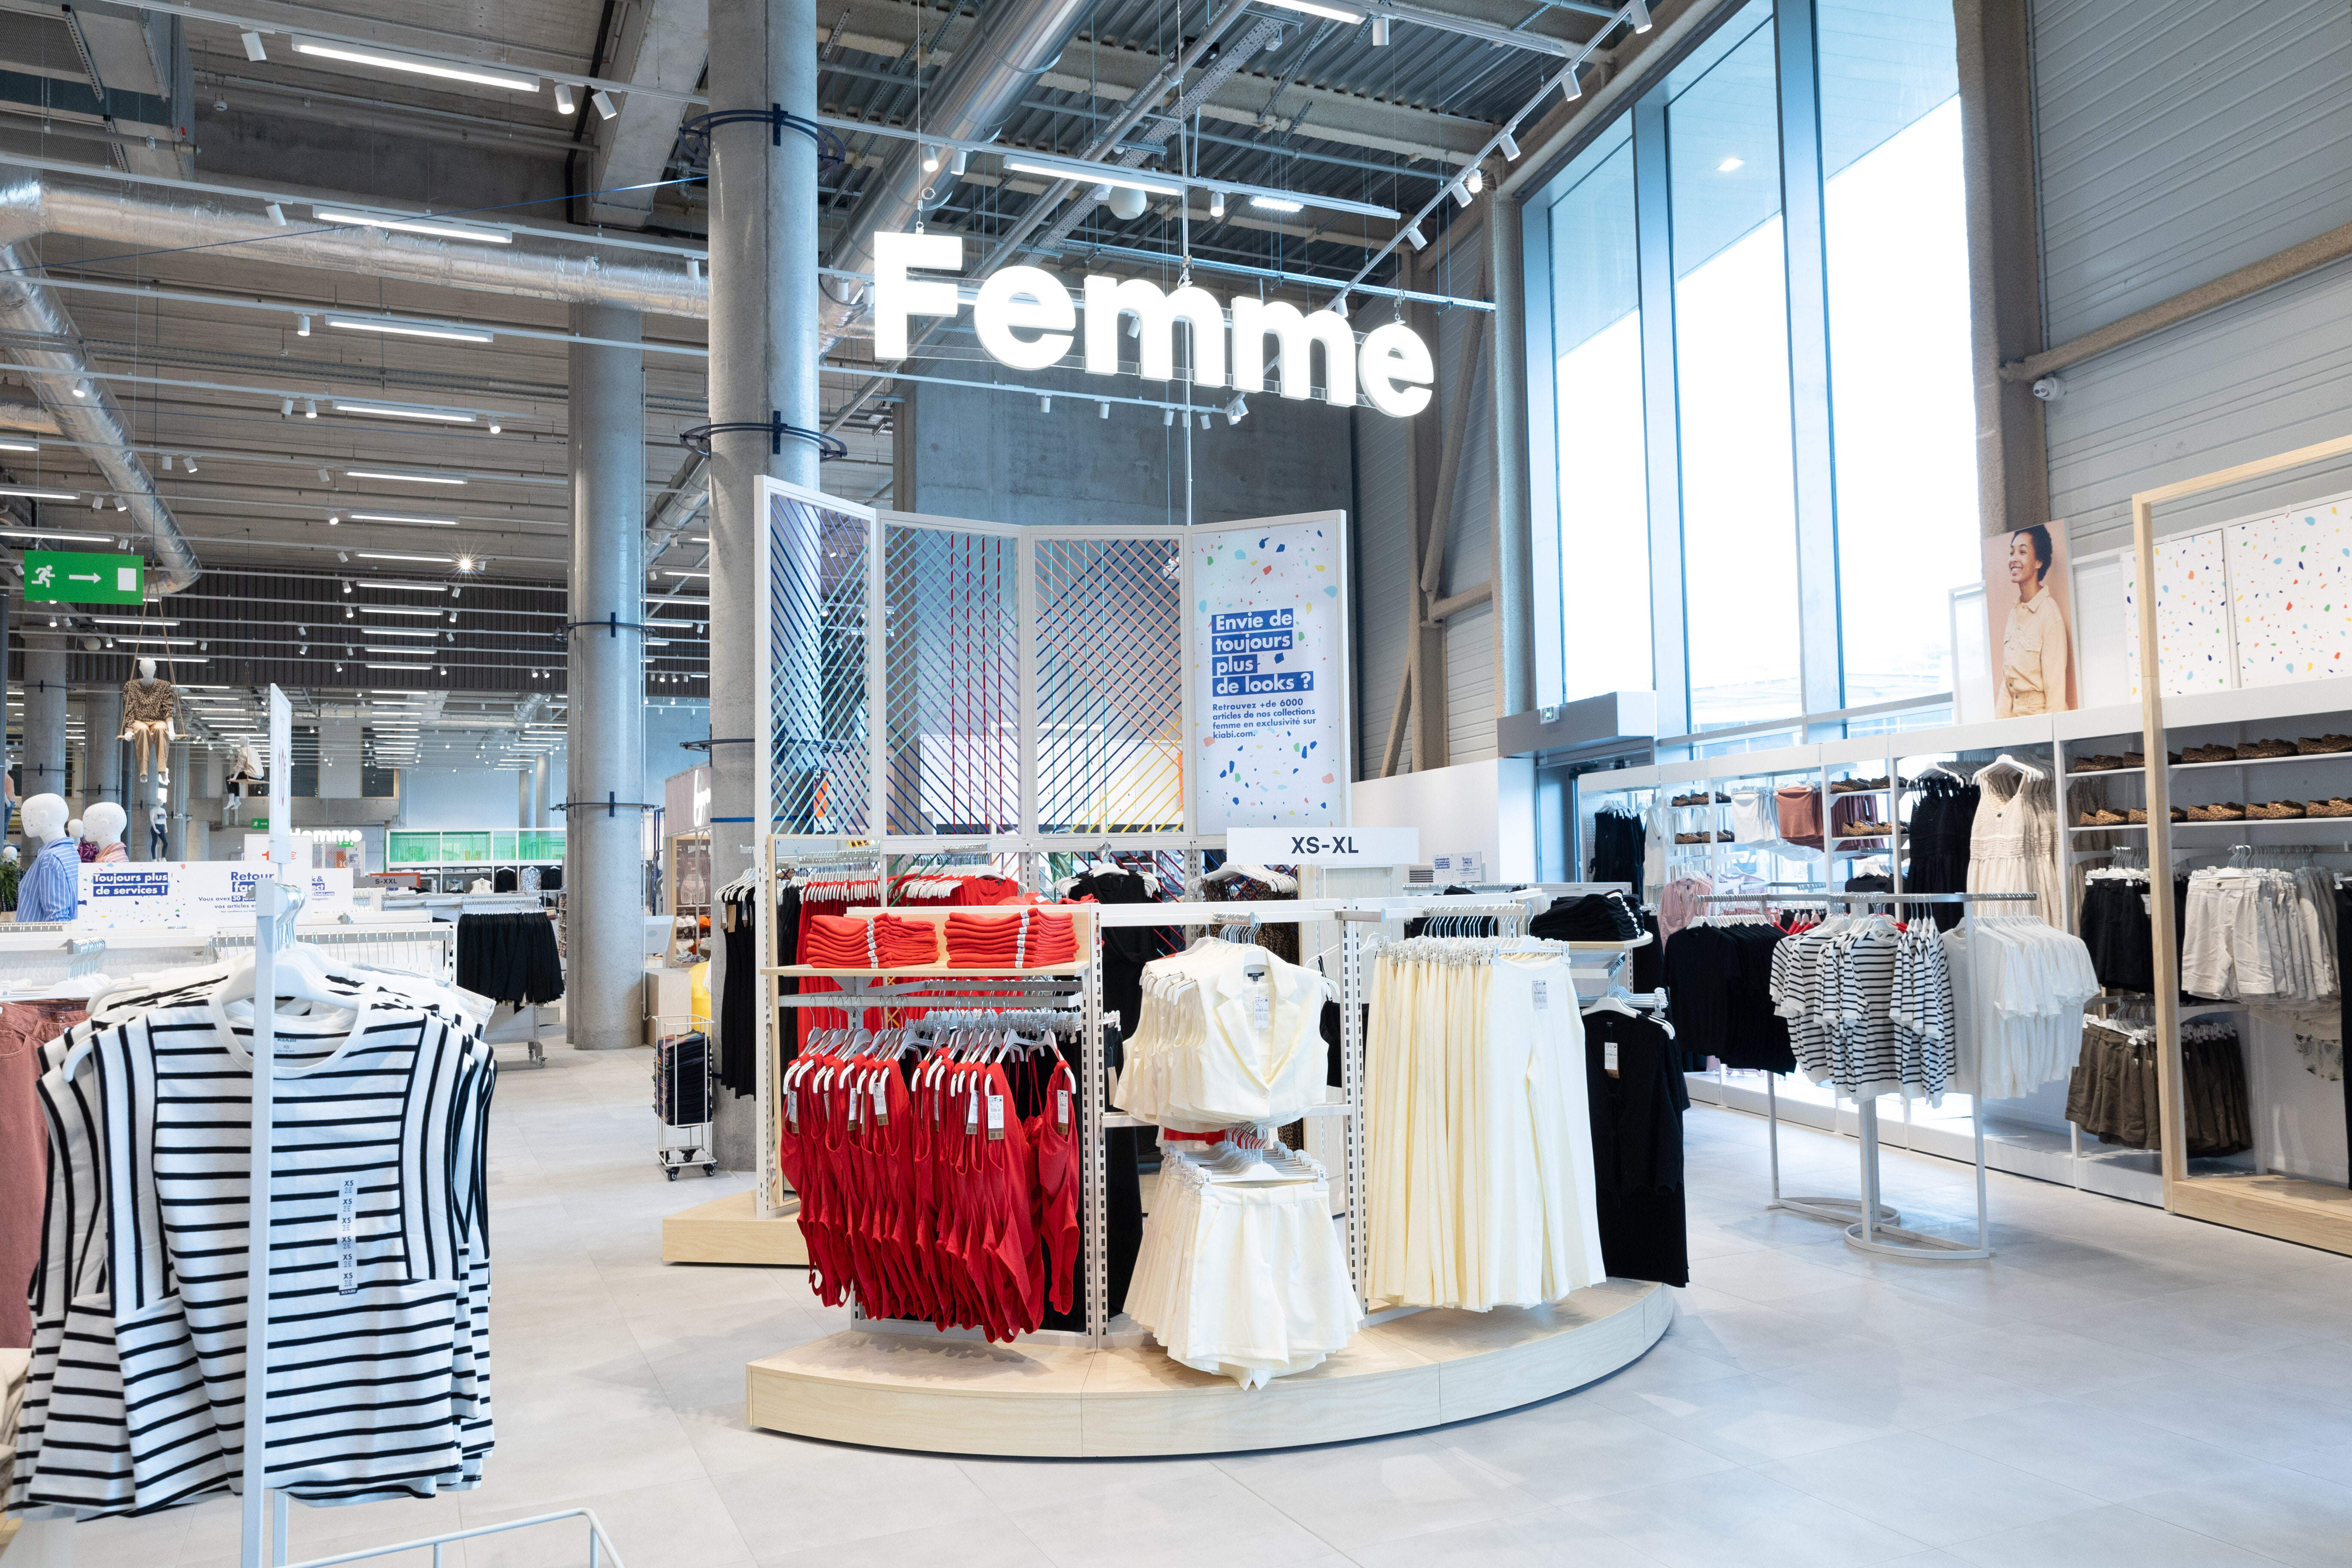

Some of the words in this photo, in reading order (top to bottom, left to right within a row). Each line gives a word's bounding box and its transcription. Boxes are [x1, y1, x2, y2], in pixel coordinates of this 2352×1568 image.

[874, 231, 1434, 418] Femme
[1216, 612, 1263, 631] Envie
[1269, 609, 1292, 627] de
[1216, 634, 1290, 653] toujours
[1216, 655, 1253, 676] plus
[1216, 677, 1239, 694] de
[1245, 674, 1295, 692] looks
[1300, 673, 1311, 689] ?
[1280, 698, 1303, 707] 6000
[1213, 712, 1241, 720] articles
[1273, 707, 1315, 717] collections
[1256, 717, 1300, 727] exclusivité
[1213, 730, 1256, 738] kiabi.com.
[1291, 836, 1359, 854] XS-XL
[94, 873, 141, 884] Toujours
[145, 873, 168, 883] plus
[95, 886, 110, 895] de
[113, 885, 158, 894] services
[161, 885, 165, 894] !
[234, 882, 257, 892] fac
